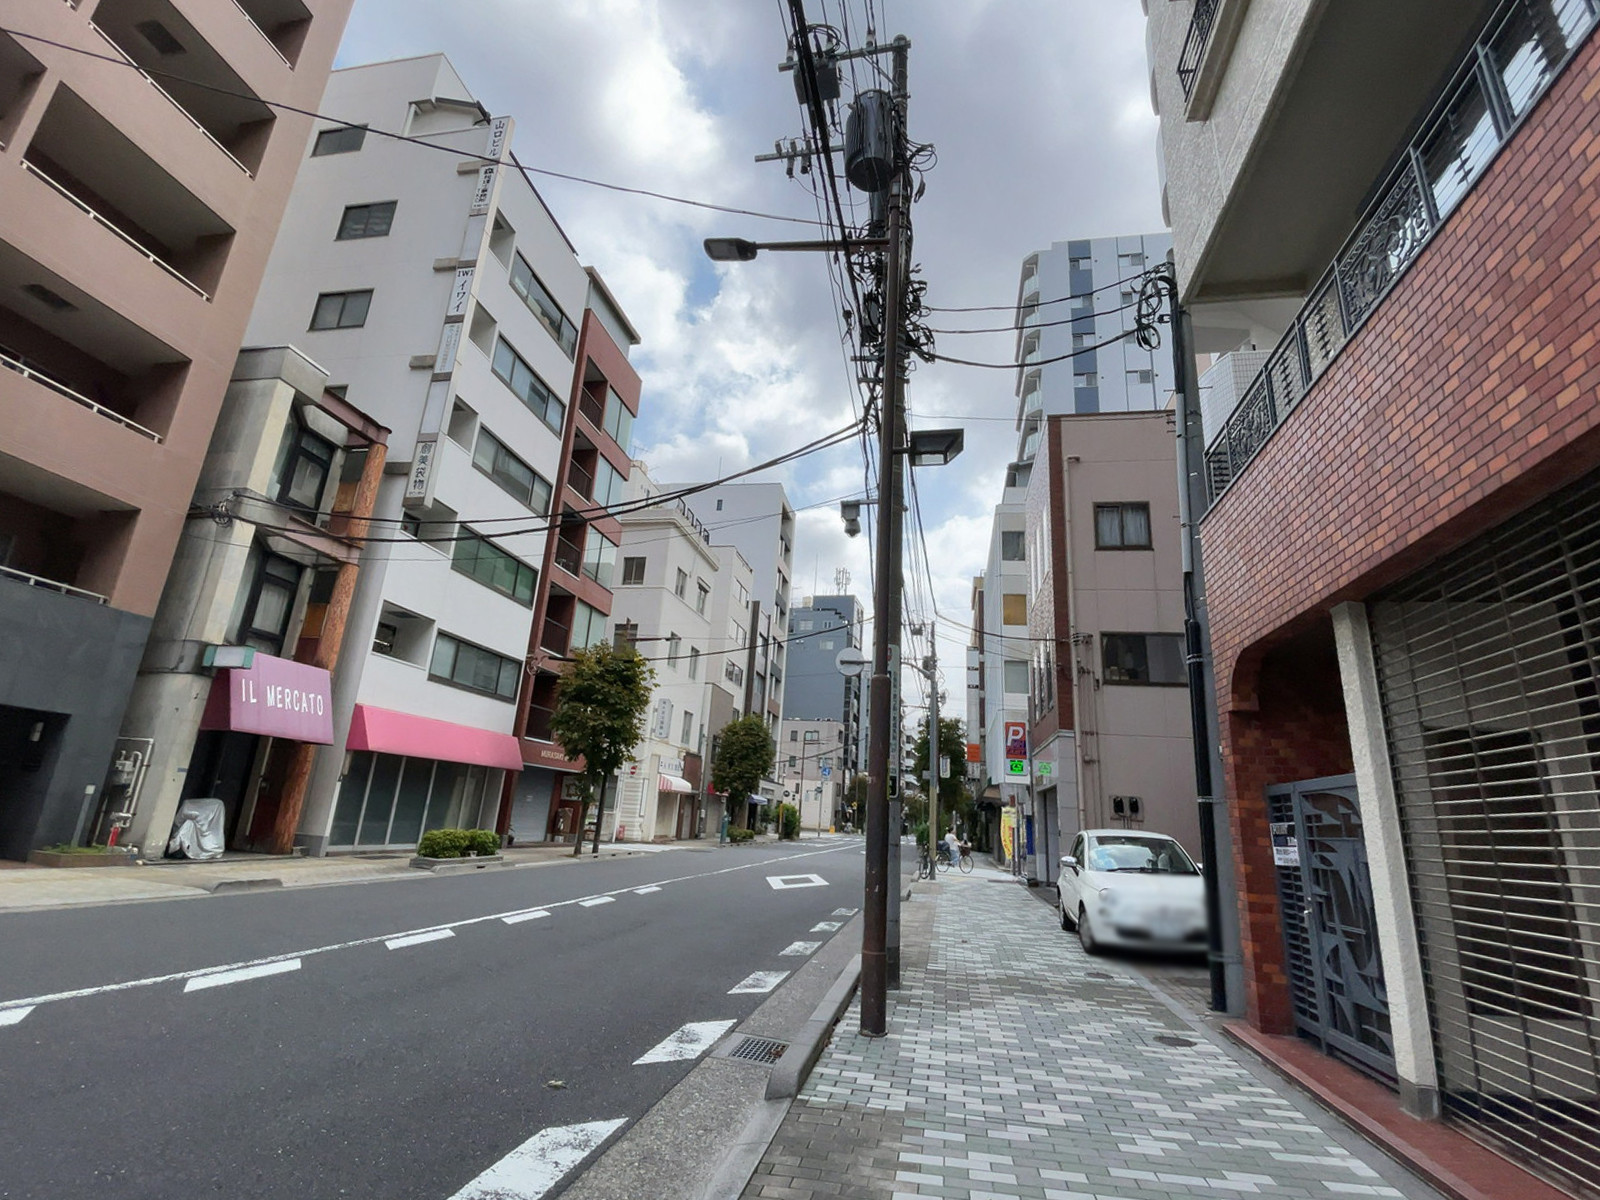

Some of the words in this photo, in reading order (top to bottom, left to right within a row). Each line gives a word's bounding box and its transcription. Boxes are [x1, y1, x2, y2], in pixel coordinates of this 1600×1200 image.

[488, 120, 505, 157] 山口ビル
[453, 279, 467, 312] イワイ
[242, 679, 257, 704] IL
[266, 684, 324, 716] MERCATO
[1007, 726, 1024, 746] P
